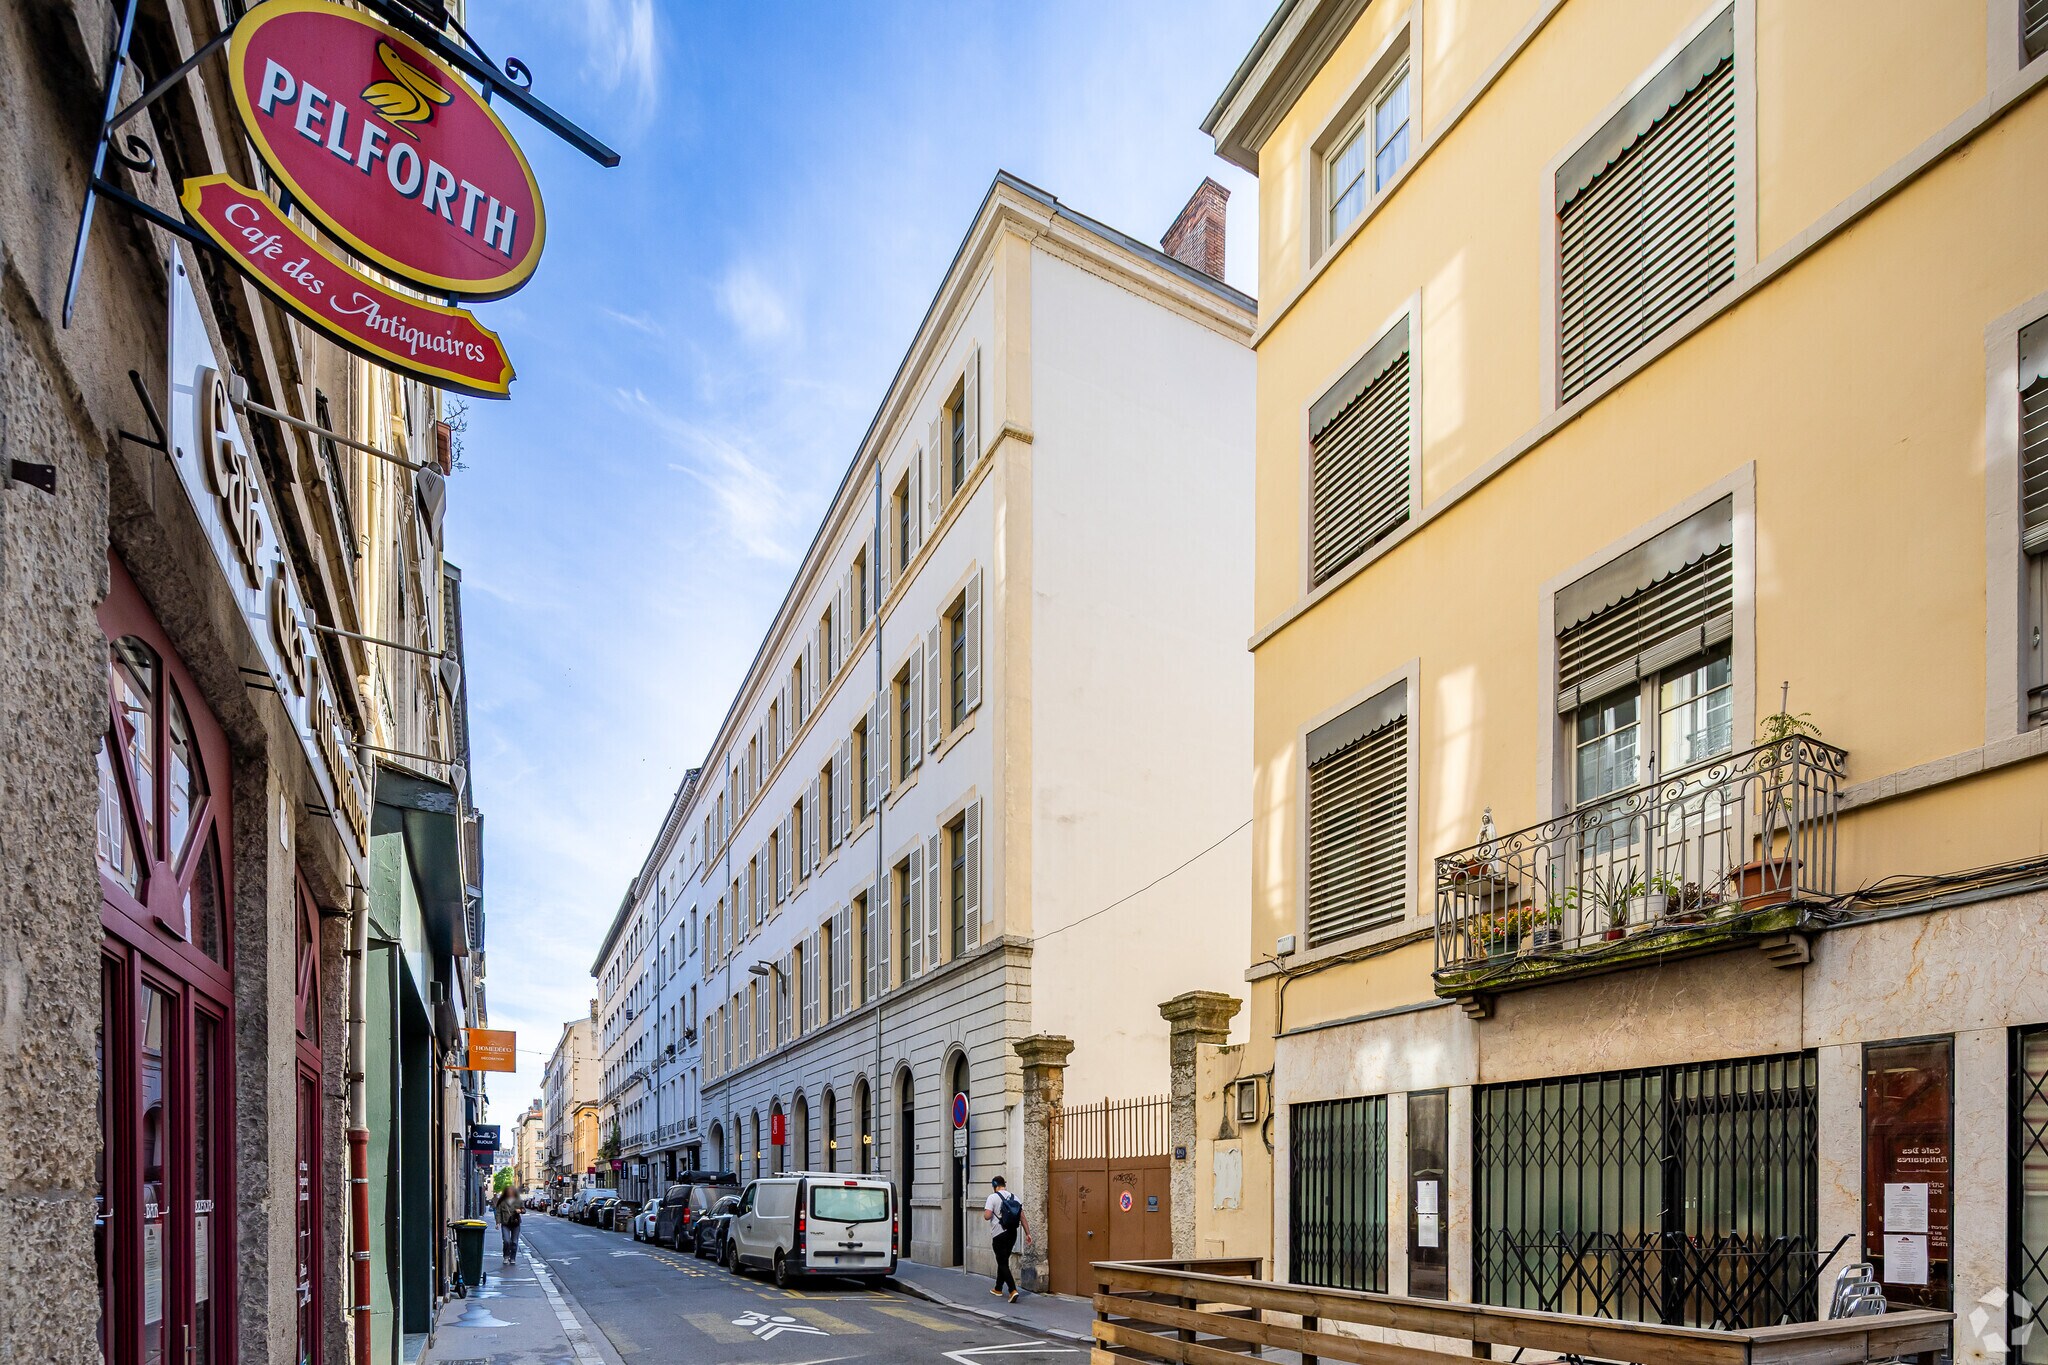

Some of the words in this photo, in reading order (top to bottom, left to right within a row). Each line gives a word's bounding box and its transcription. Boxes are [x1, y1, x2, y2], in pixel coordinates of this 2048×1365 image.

[257, 57, 517, 259] PELFORTH
[224, 203, 283, 260] Café
[281, 257, 325, 295] des
[329, 291, 486, 363] Antiquaires
[201, 368, 264, 591] Café
[272, 560, 307, 697] des
